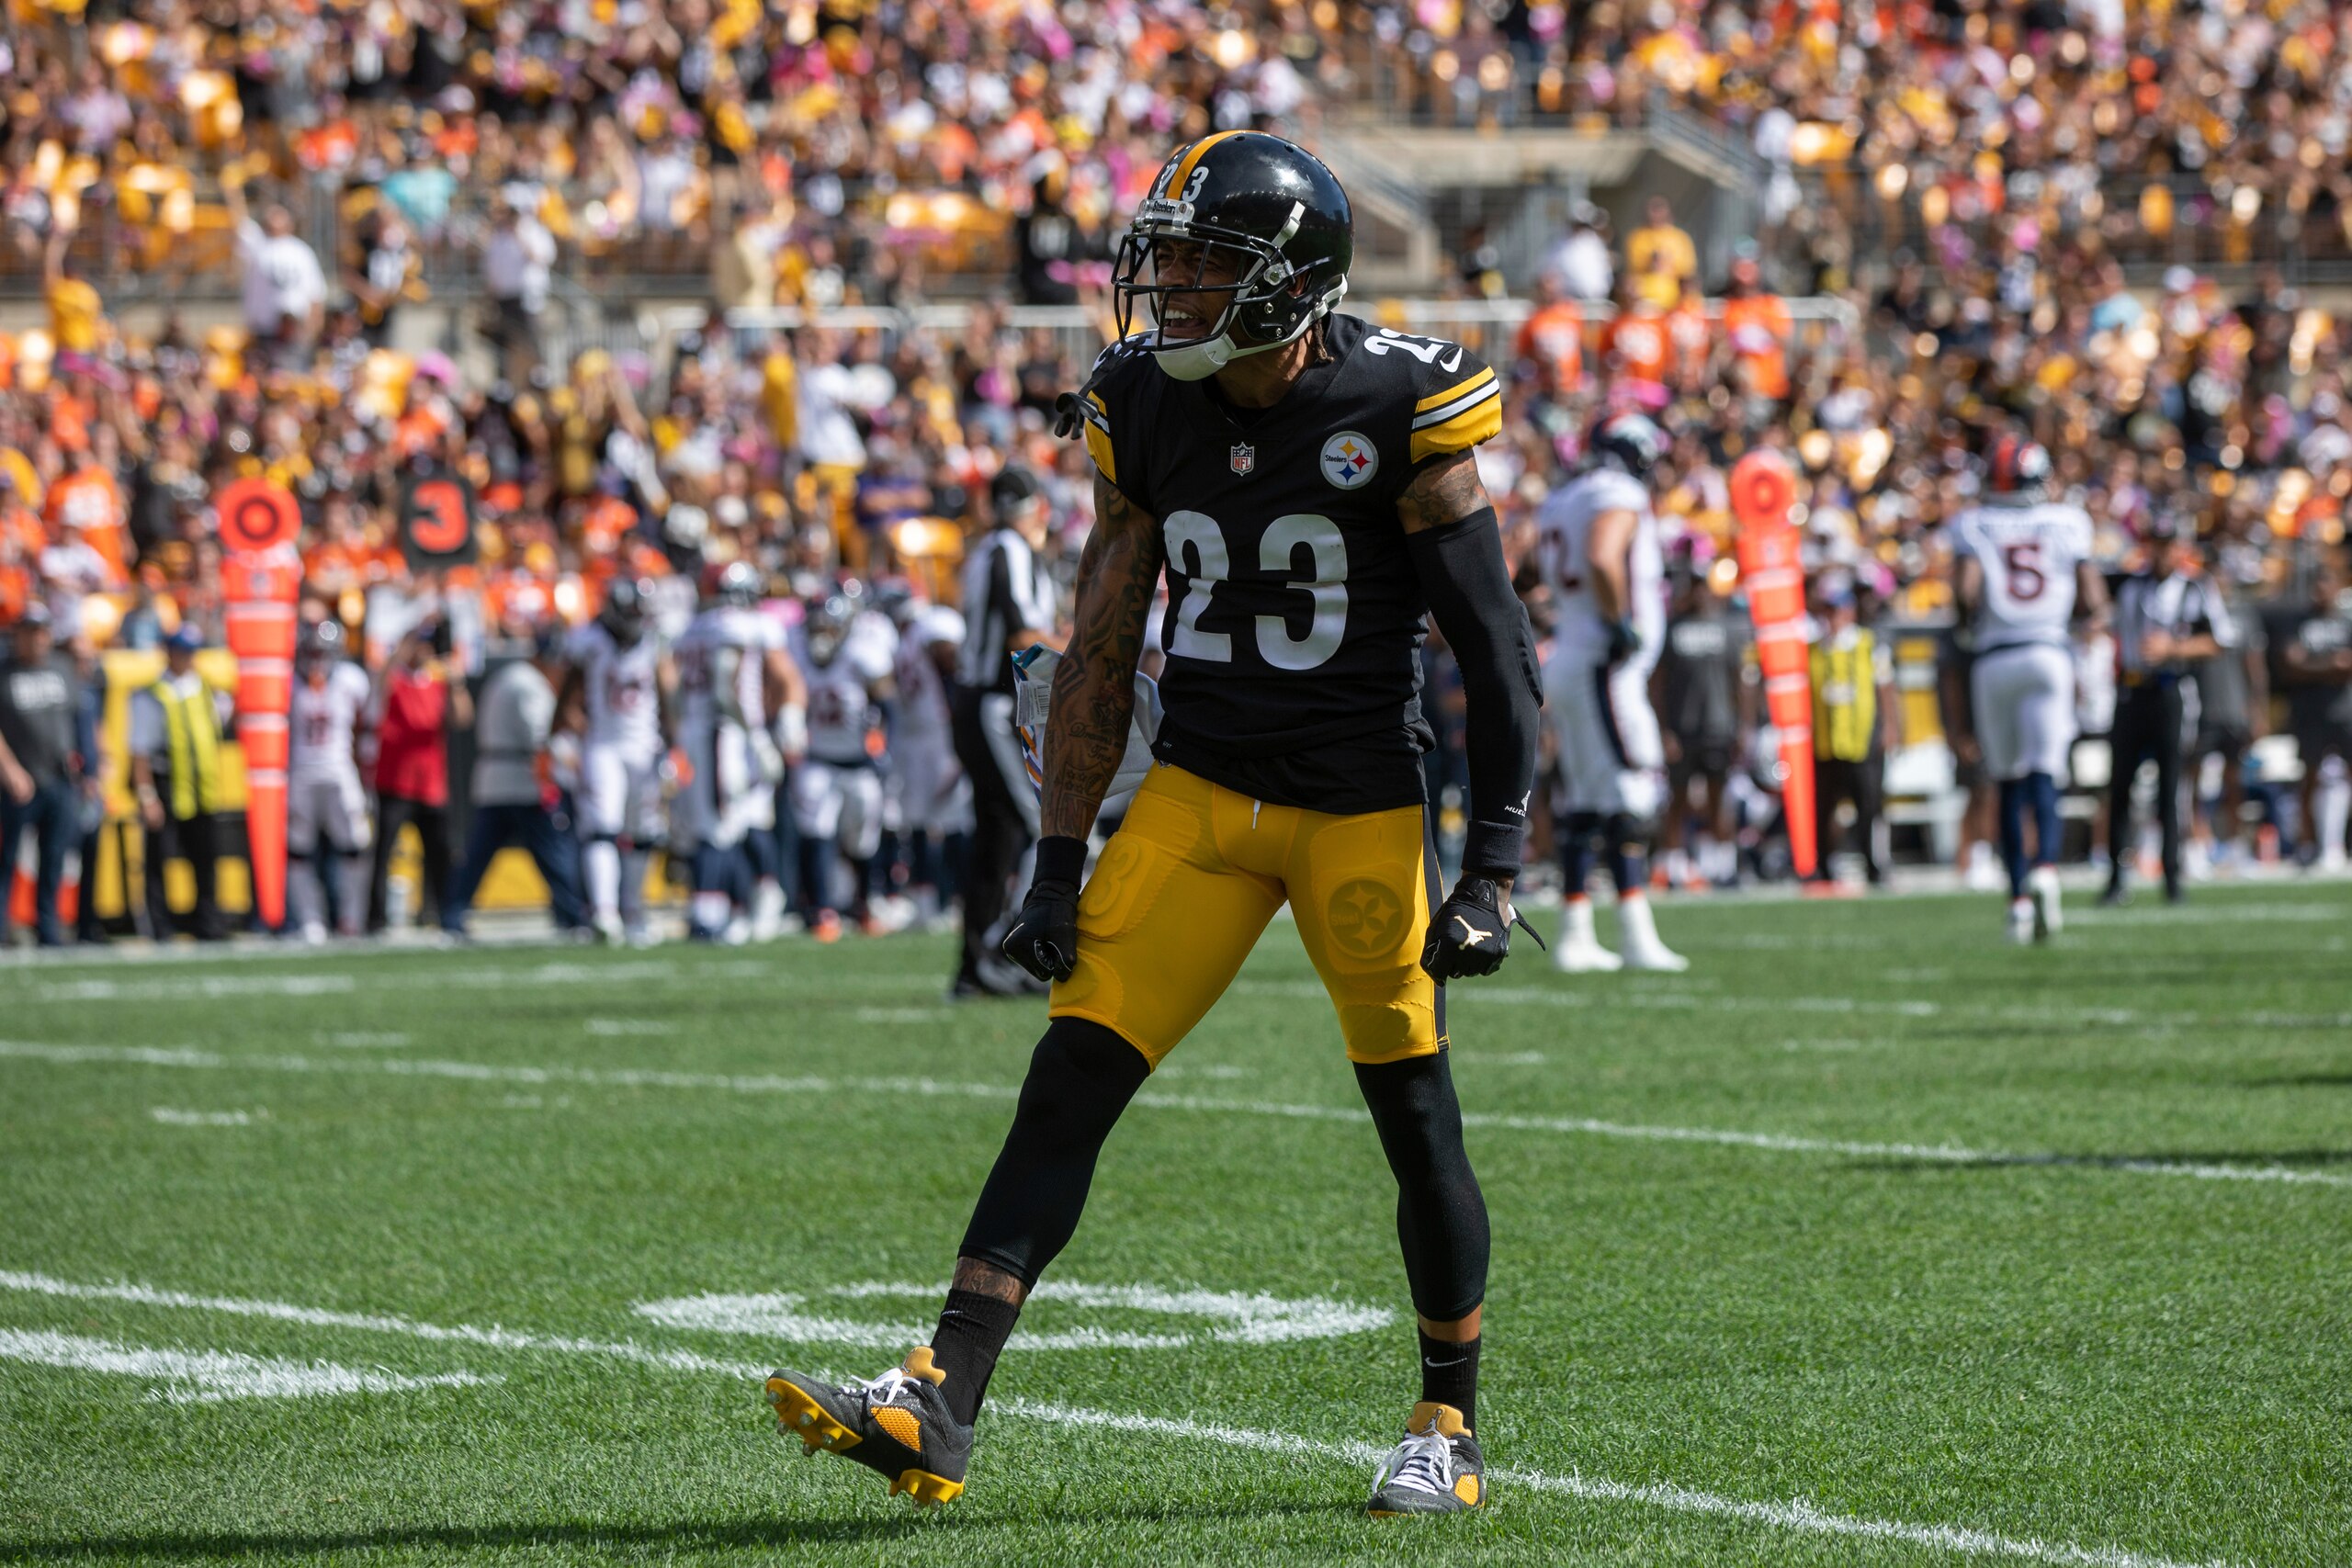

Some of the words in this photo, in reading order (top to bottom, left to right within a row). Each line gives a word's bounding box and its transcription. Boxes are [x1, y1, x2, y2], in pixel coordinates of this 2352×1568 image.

[1234, 457, 1251, 469] NFL
[1325, 454, 1348, 463] Steelers
[412, 479, 469, 553] 3
[1163, 510, 1349, 671] 23
[2004, 542, 2046, 603] 5
